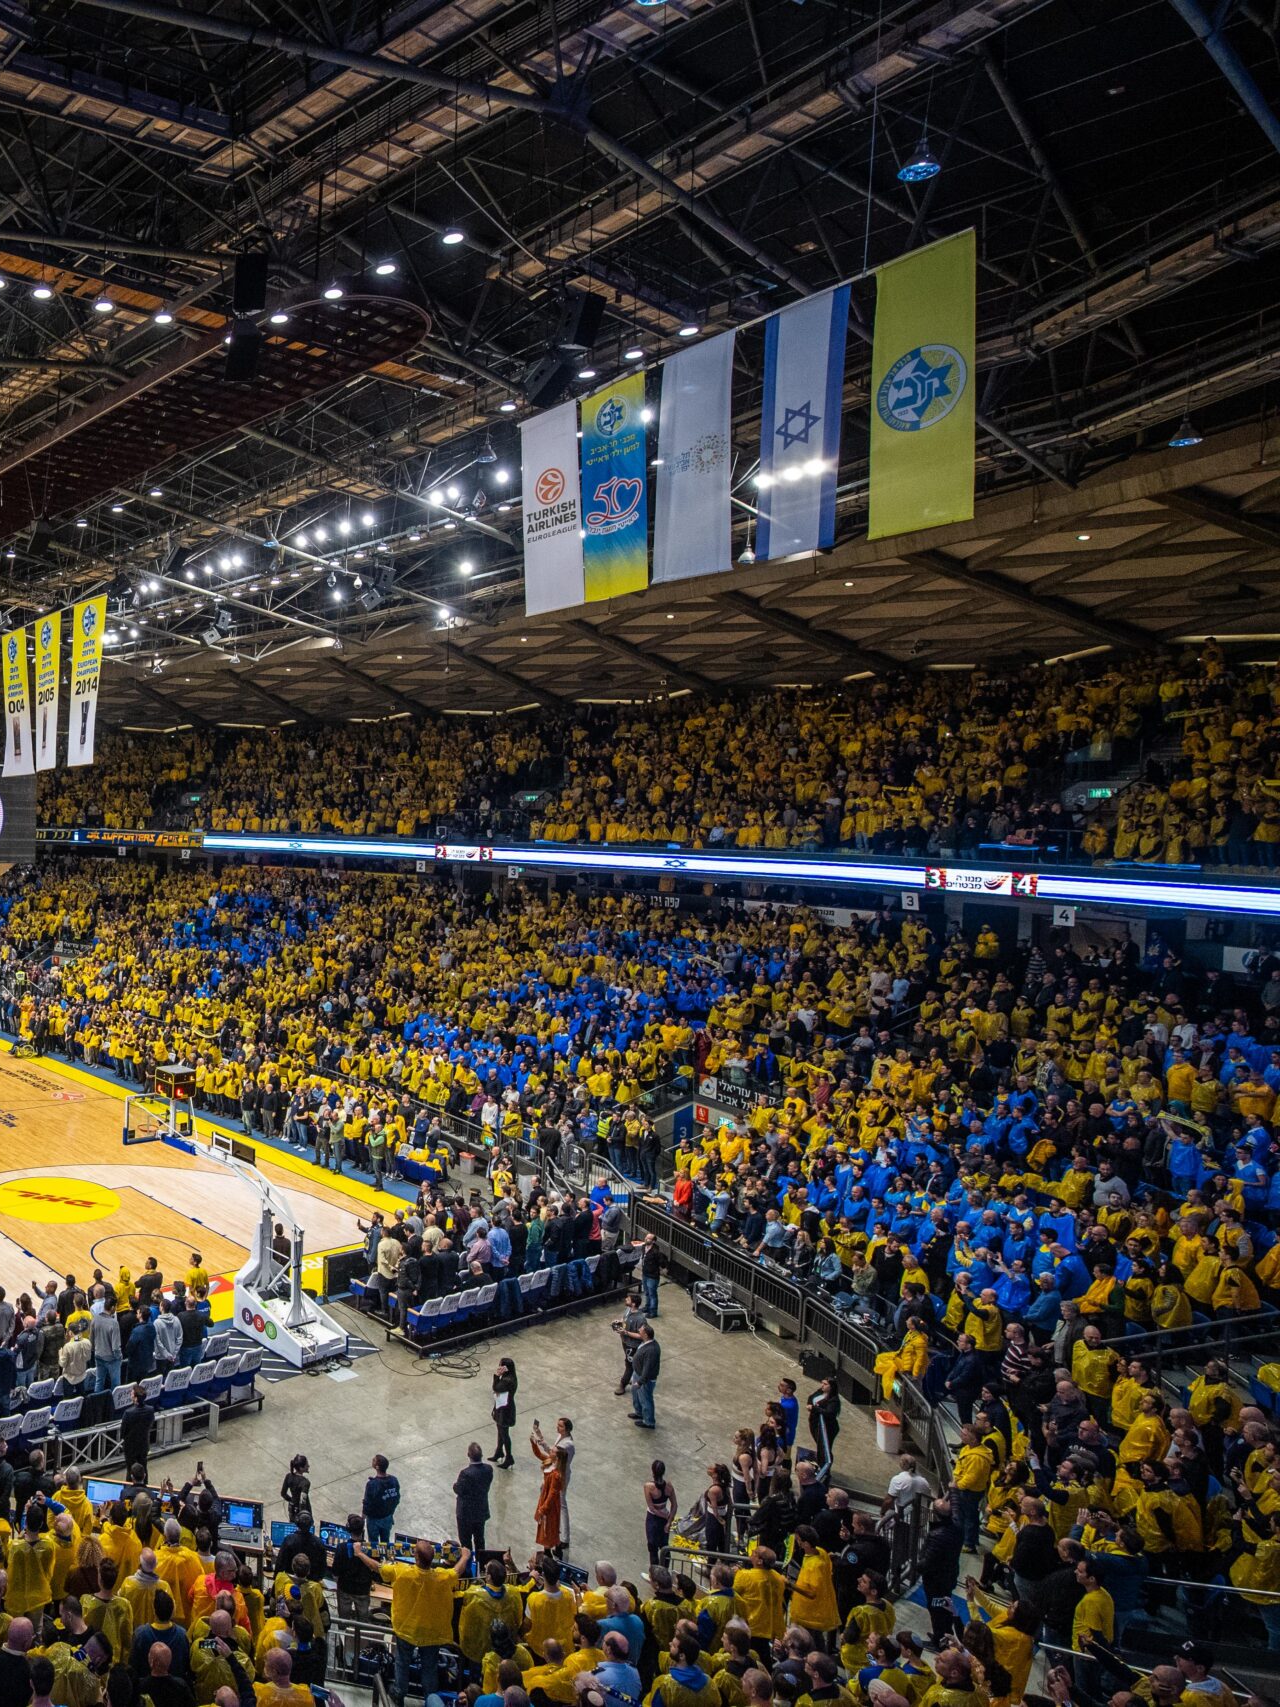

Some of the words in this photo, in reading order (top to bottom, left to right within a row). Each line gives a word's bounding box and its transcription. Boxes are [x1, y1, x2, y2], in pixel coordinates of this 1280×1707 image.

[526, 499, 576, 523] TURKISH
[526, 510, 577, 535] AIRLINES
[527, 523, 577, 543] EUROLEAGUE
[75, 676, 98, 695] 2014
[101, 831, 156, 845] SUPPORTERS
[436, 845, 444, 858] 2
[481, 847, 489, 860] 3
[510, 868, 516, 876] 3
[929, 868, 941, 888] 3
[1016, 874, 1033, 894] 4
[906, 895, 914, 907] 3
[1059, 909, 1070, 922] 4
[718, 1079, 751, 1098] עזריאלי
[717, 1093, 738, 1107] אביב
[680, 1126, 687, 1138] 3
[17, 1190, 97, 1208] DHL
